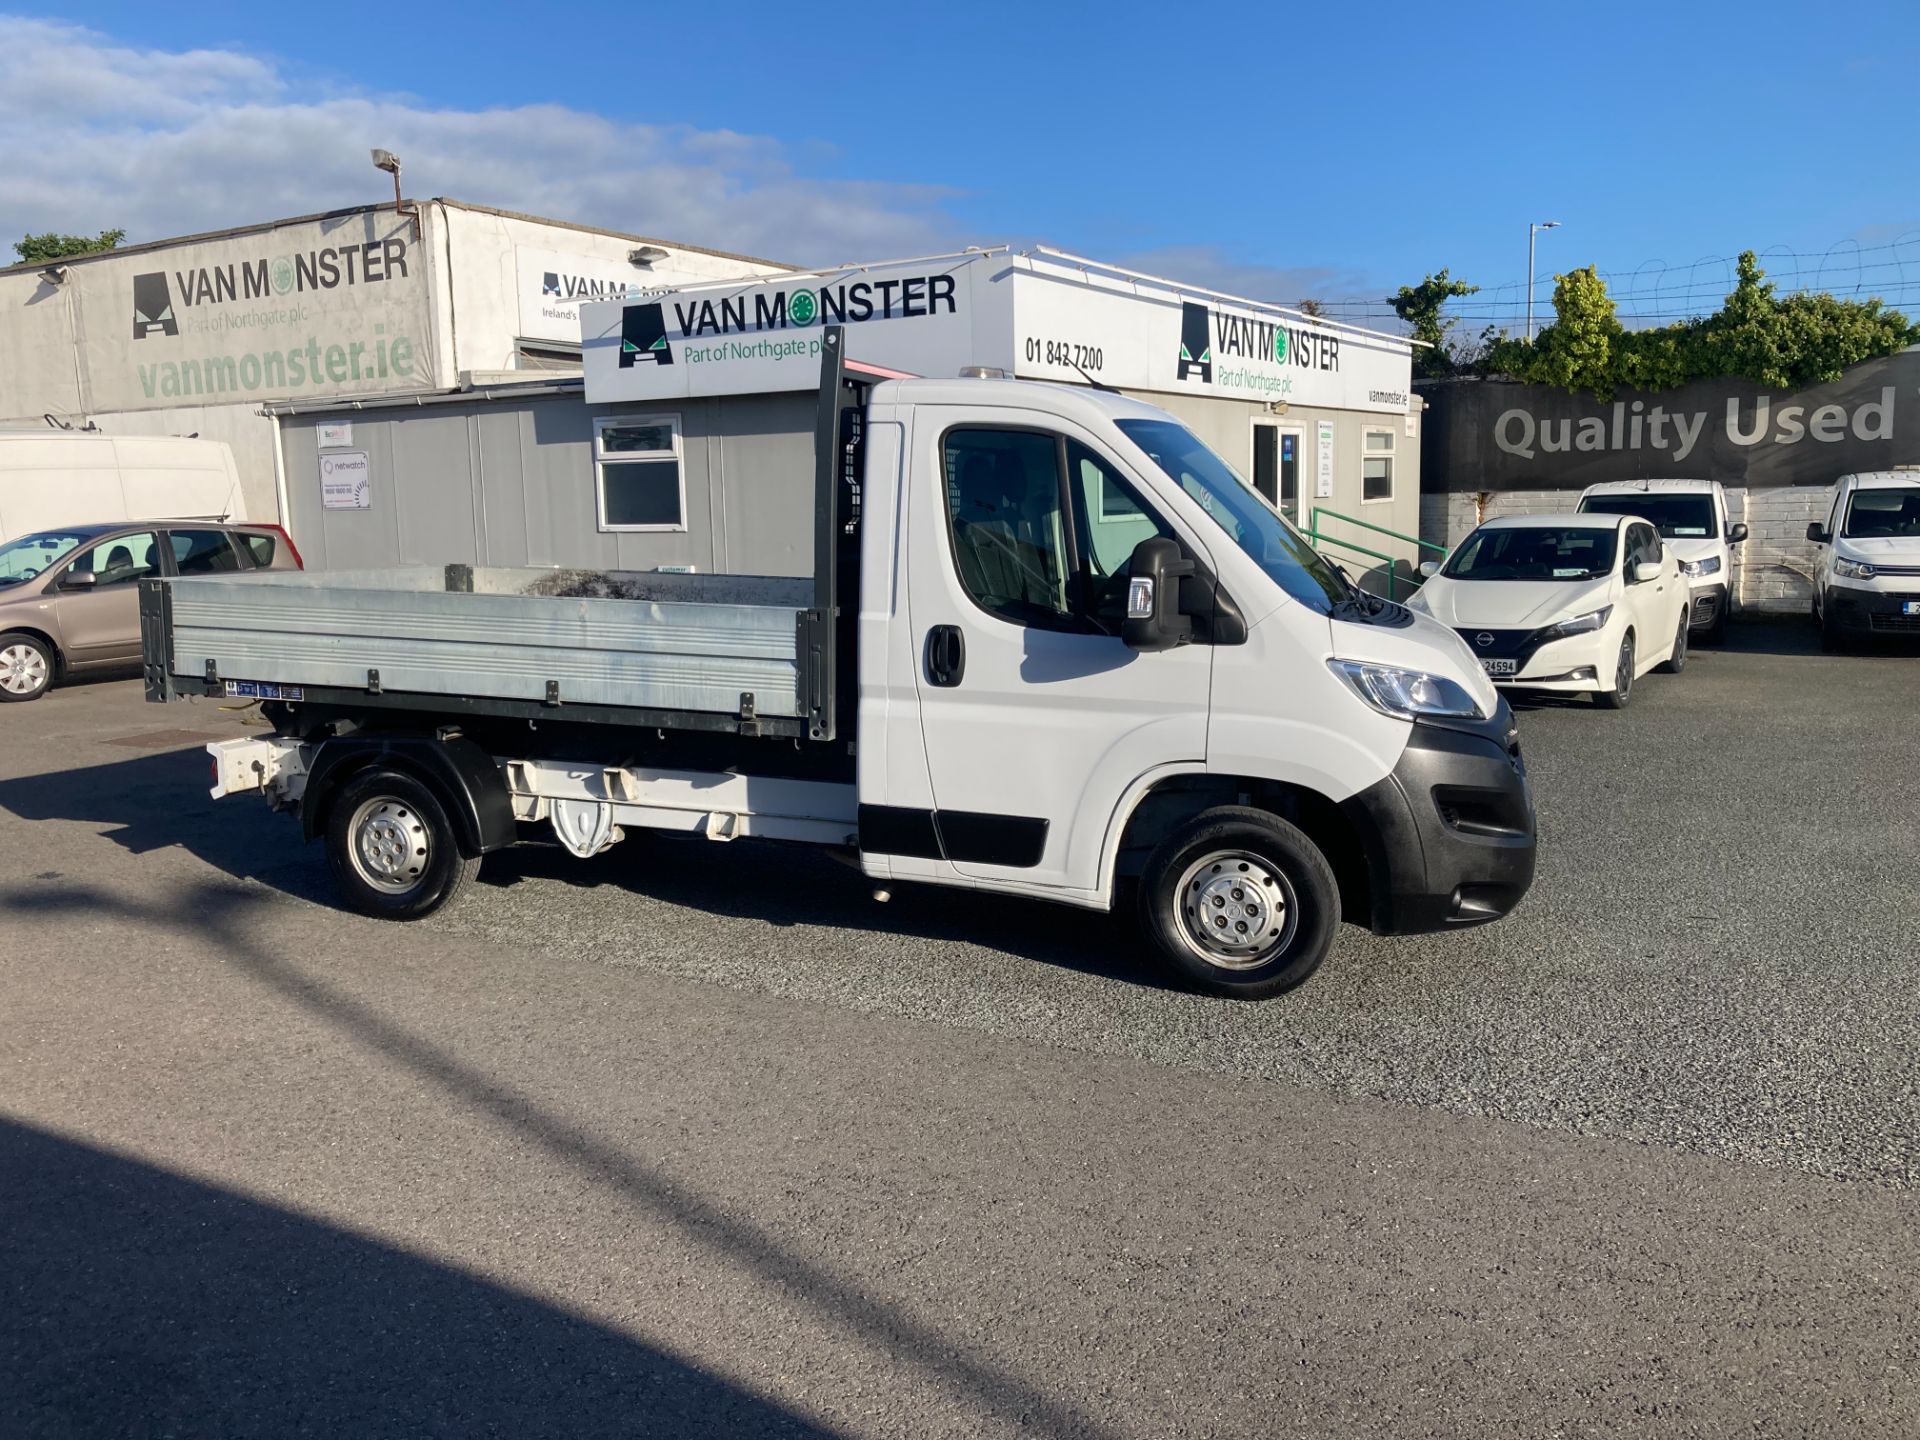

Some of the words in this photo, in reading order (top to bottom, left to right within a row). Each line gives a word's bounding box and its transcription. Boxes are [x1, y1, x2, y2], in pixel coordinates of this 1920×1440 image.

[176, 263, 237, 307] VAN
[242, 238, 409, 299] MONSTER
[186, 314, 210, 334] Part
[211, 313, 224, 331] of
[225, 306, 288, 330] Northgate
[289, 302, 309, 327] plc
[542, 307, 578, 321] Ireland's
[674, 295, 746, 337] VAN
[755, 274, 956, 331] MONSTER
[684, 344, 712, 364] Part
[712, 341, 729, 361] of
[731, 337, 806, 363] Northgate
[809, 334, 824, 359] pl
[1026, 337, 1041, 363] 01
[1046, 340, 1070, 367] 842
[1074, 344, 1103, 371] 7200
[1215, 311, 1254, 359] VAN
[1258, 321, 1339, 373] MONSTER
[137, 323, 414, 398] vanmonster.ie
[1218, 366, 1235, 387] Part
[1235, 368, 1244, 388] of
[1245, 370, 1281, 396] Northgate
[1281, 375, 1293, 397] plc
[1369, 389, 1408, 406] vanmonster.ie
[1494, 400, 1708, 463] Quality
[1725, 386, 1897, 446] Used
[335, 460, 366, 470] netwatch
